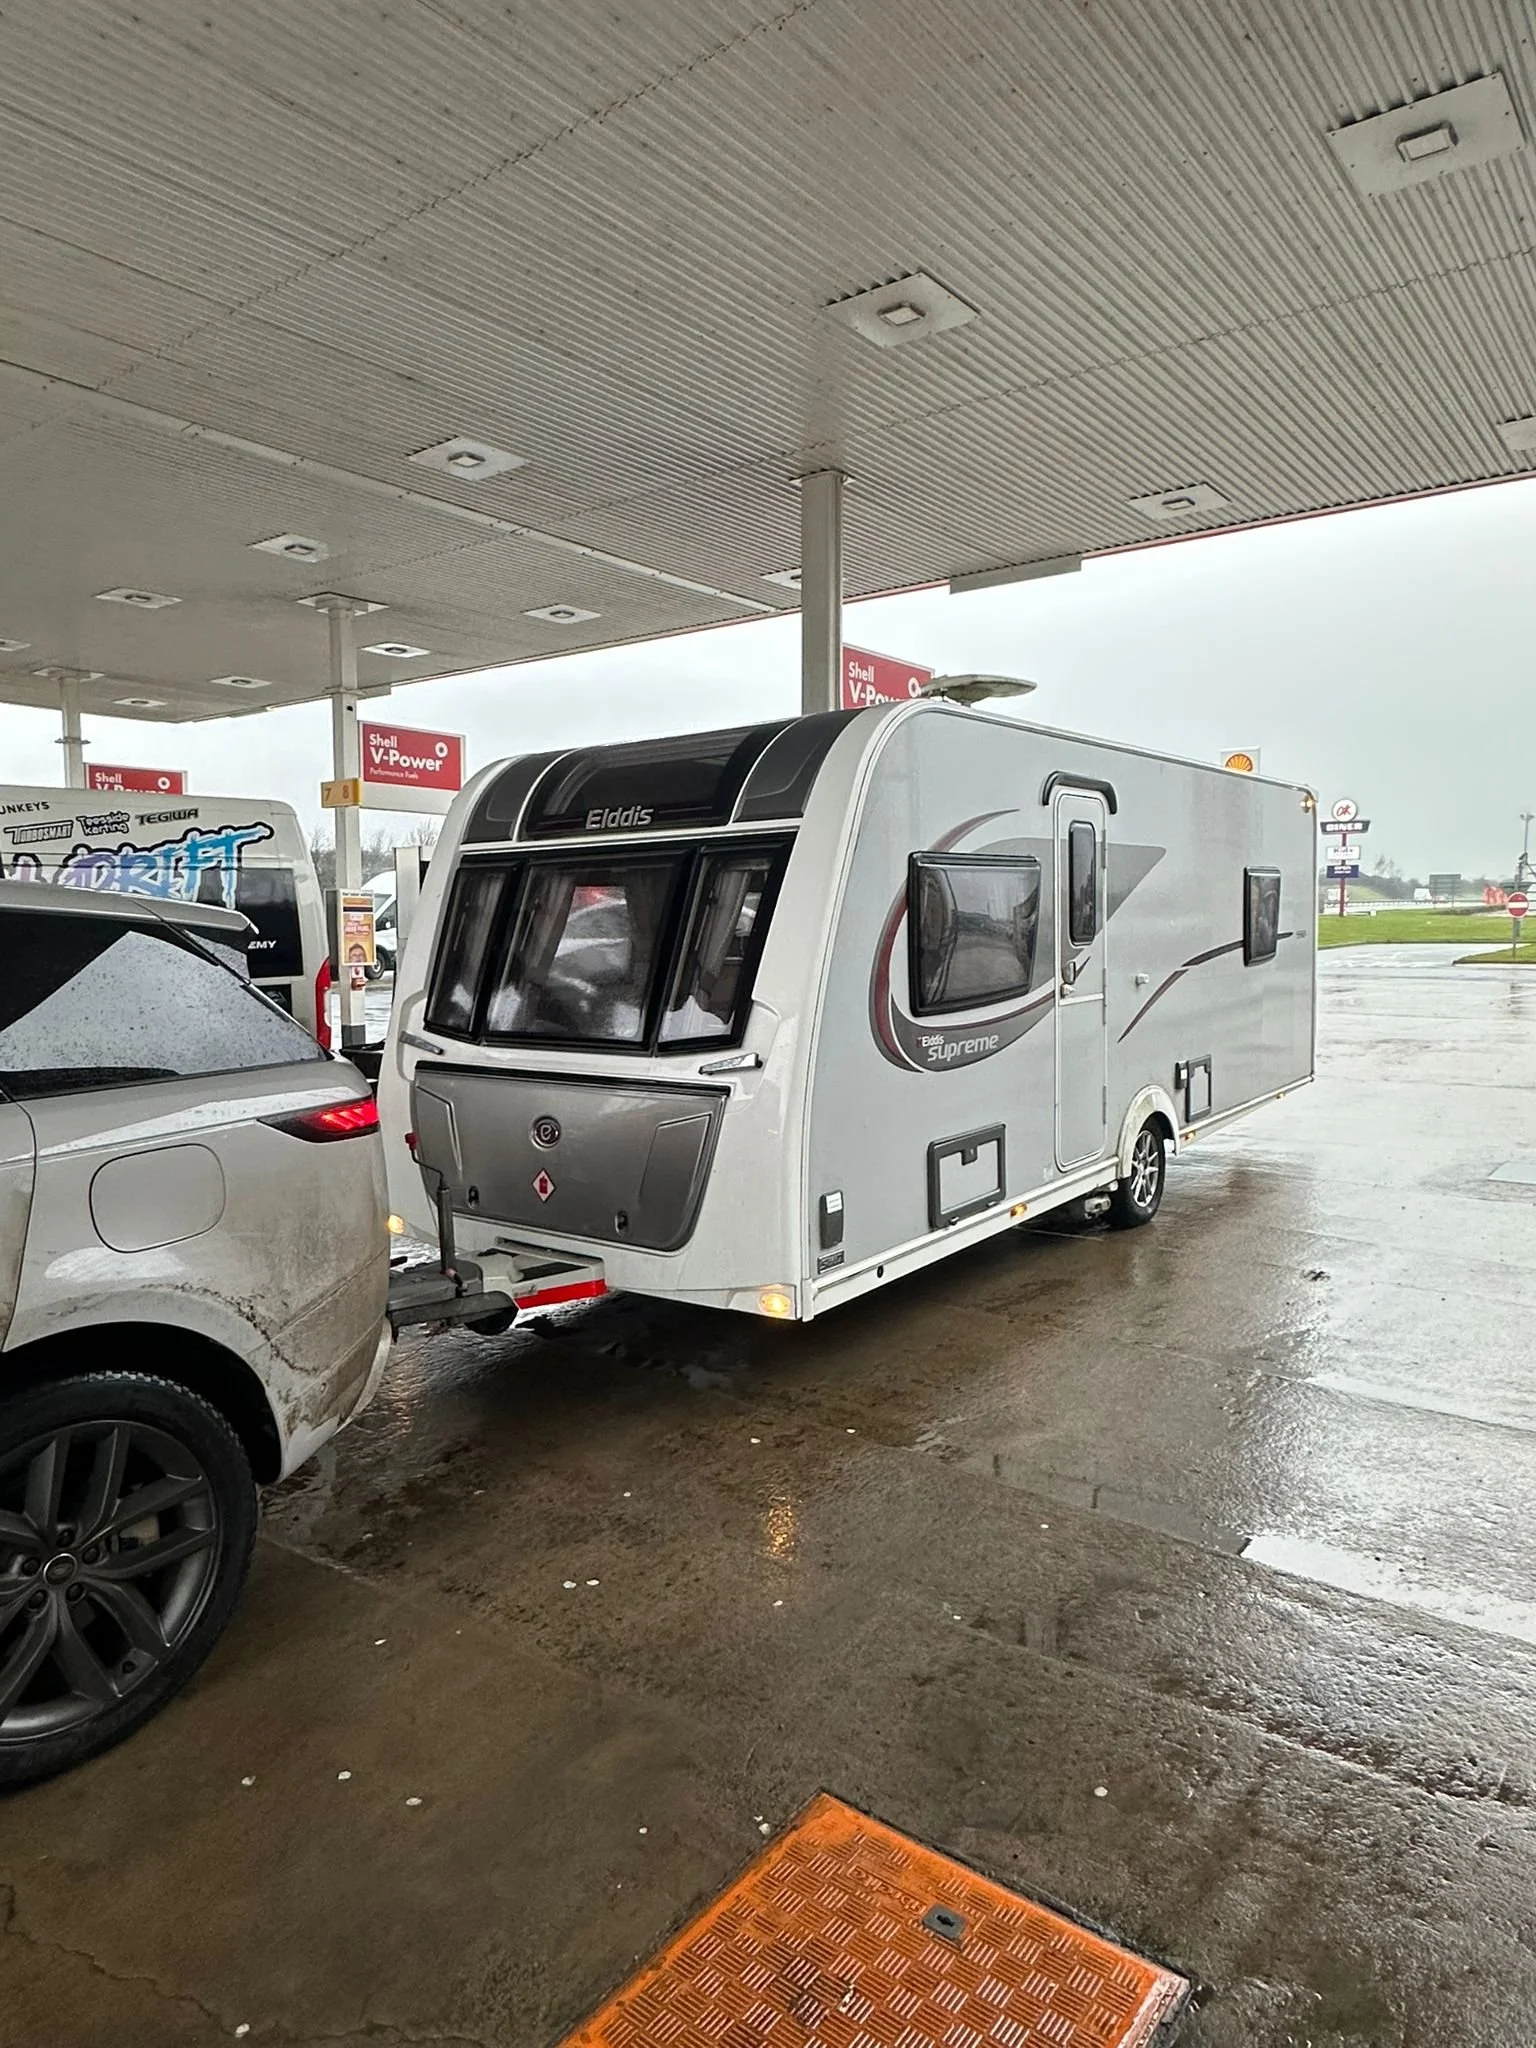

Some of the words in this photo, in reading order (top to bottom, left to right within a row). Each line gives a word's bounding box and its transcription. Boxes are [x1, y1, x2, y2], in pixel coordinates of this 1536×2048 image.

[848, 661, 874, 683] Shell
[369, 733, 397, 748] Shell
[369, 747, 443, 771] V-Power
[95, 772, 122, 783] Shell
[325, 787, 332, 801] 7
[342, 785, 349, 799] 8
[135, 808, 199, 825] TEGIWA
[585, 805, 654, 830] Elddis
